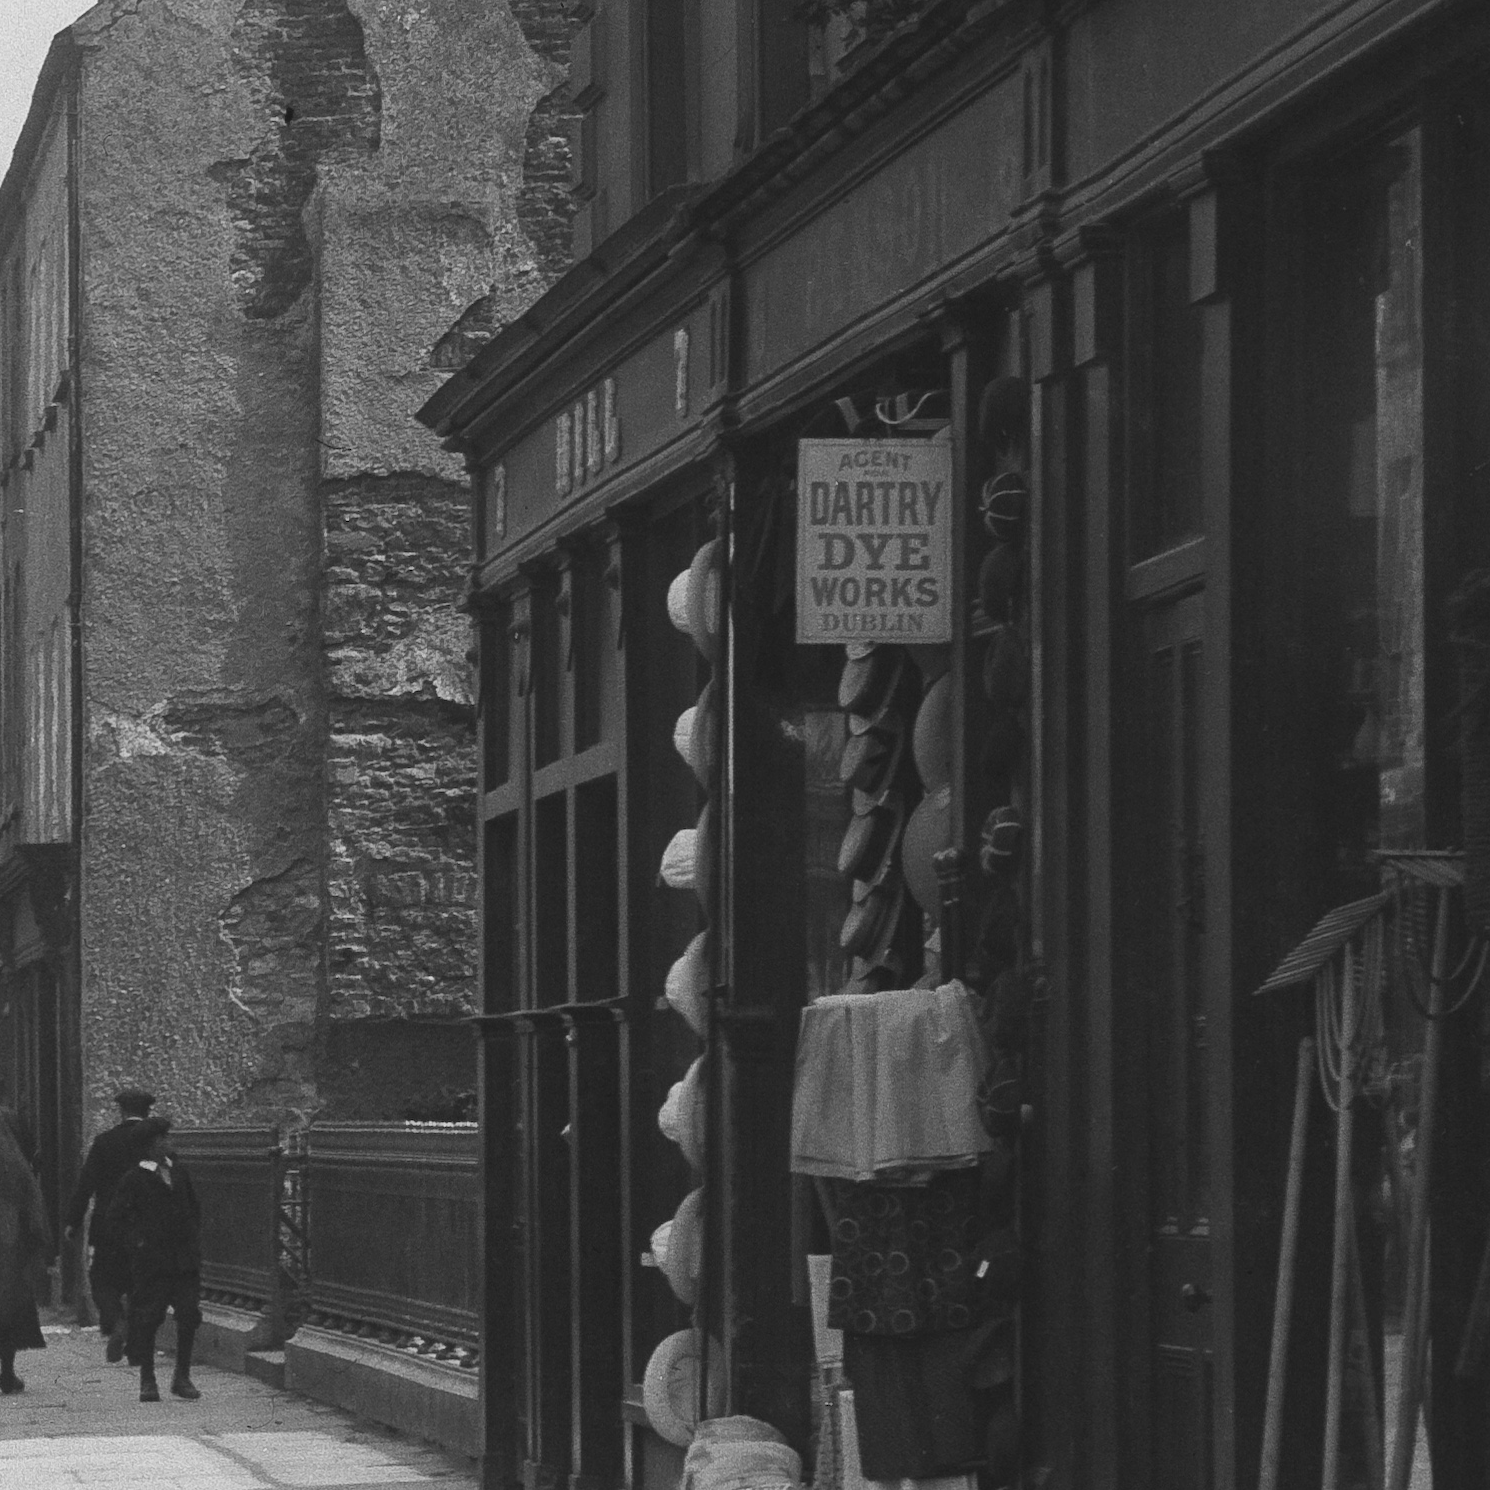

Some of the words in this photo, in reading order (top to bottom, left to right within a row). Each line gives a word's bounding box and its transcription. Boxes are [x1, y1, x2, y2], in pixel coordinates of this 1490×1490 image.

[839, 450, 913, 473] AGENT
[810, 480, 944, 527] DARTRY
[817, 532, 931, 571] DYE
[810, 576, 939, 608] WORKS
[821, 613, 926, 633] DUBLIN
